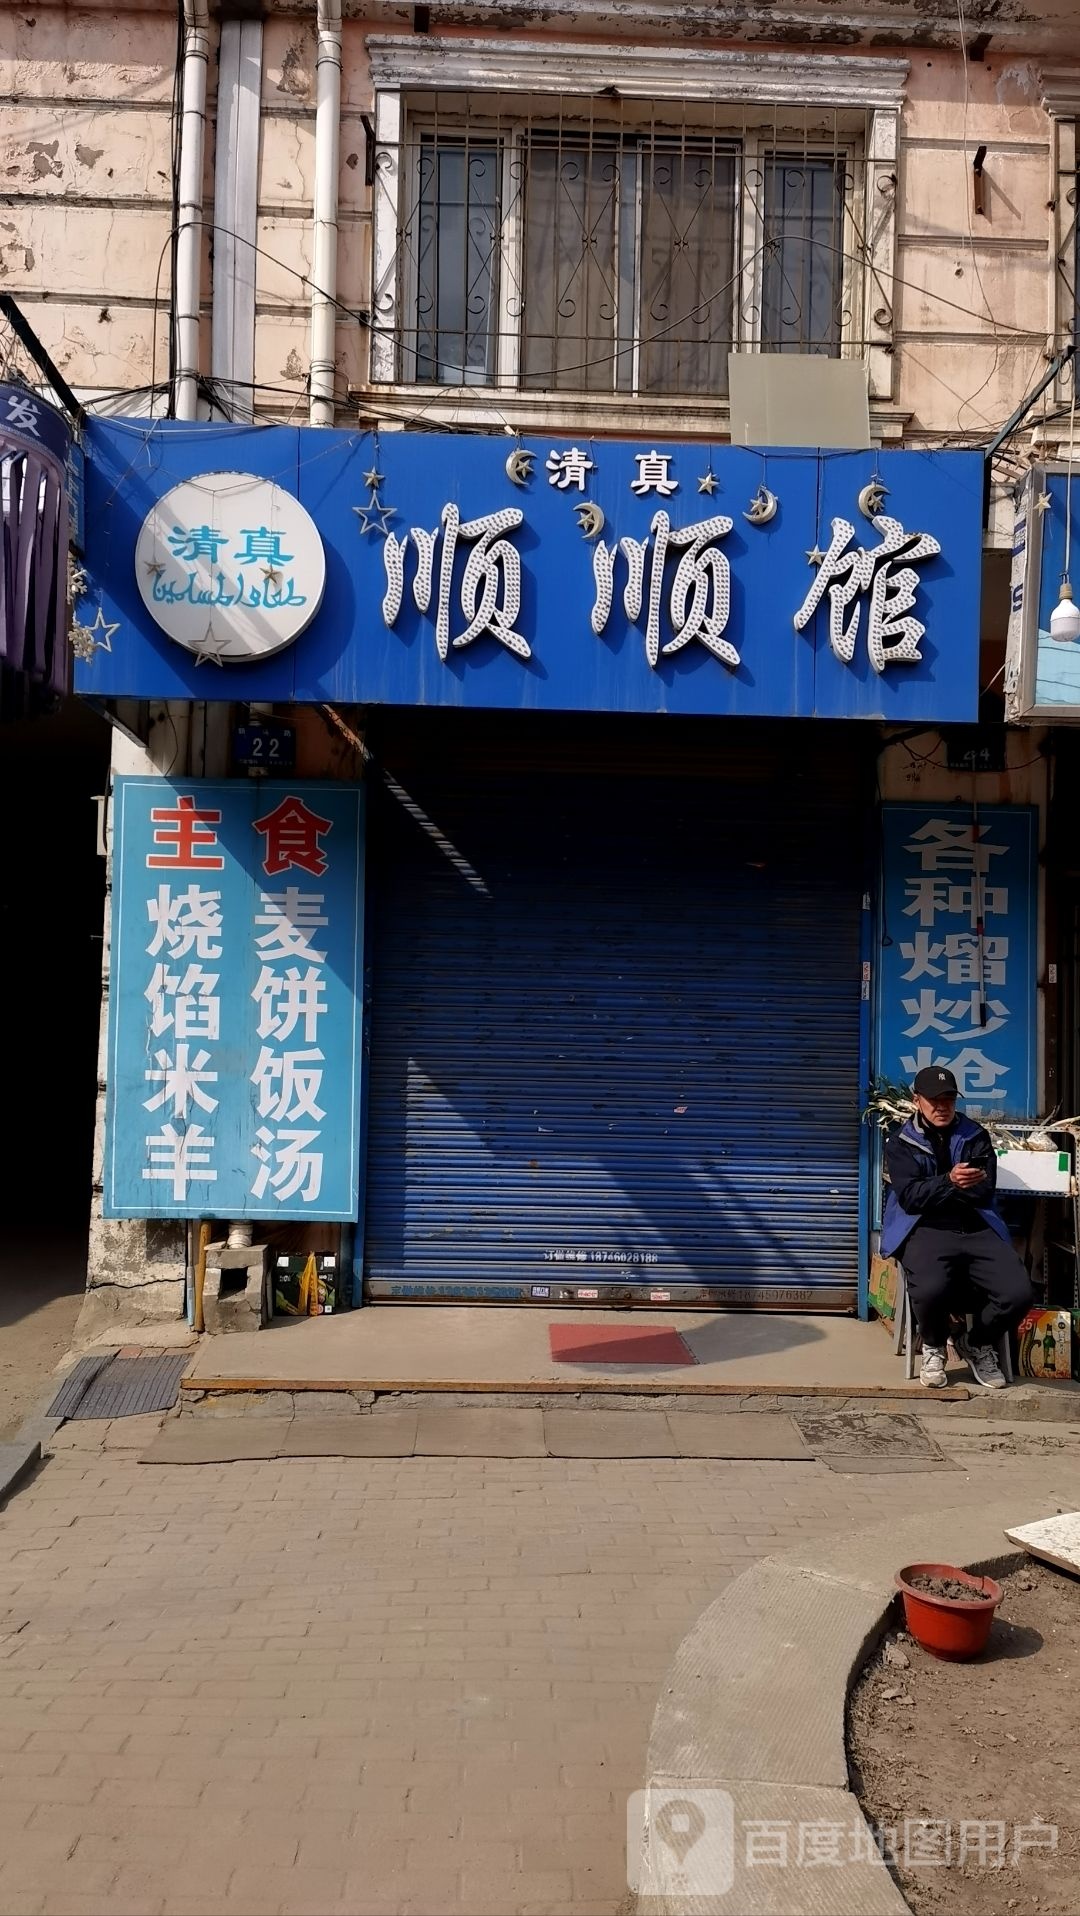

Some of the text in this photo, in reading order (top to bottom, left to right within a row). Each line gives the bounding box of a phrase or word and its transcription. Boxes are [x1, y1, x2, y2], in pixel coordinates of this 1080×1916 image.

[5, 395, 42, 437] 发
[546, 447, 679, 495] 清真
[168, 525, 294, 566] 清真
[382, 502, 941, 673] 顺顺馆
[252, 737, 280, 757] 22
[146, 795, 334, 877] 主食
[146, 883, 329, 963] 烧麦
[144, 963, 328, 1043] 馅饼
[899, 817, 1011, 1117] 各种熘炒炝
[142, 1044, 328, 1123] 米饭
[142, 1124, 326, 1202] 羊汤
